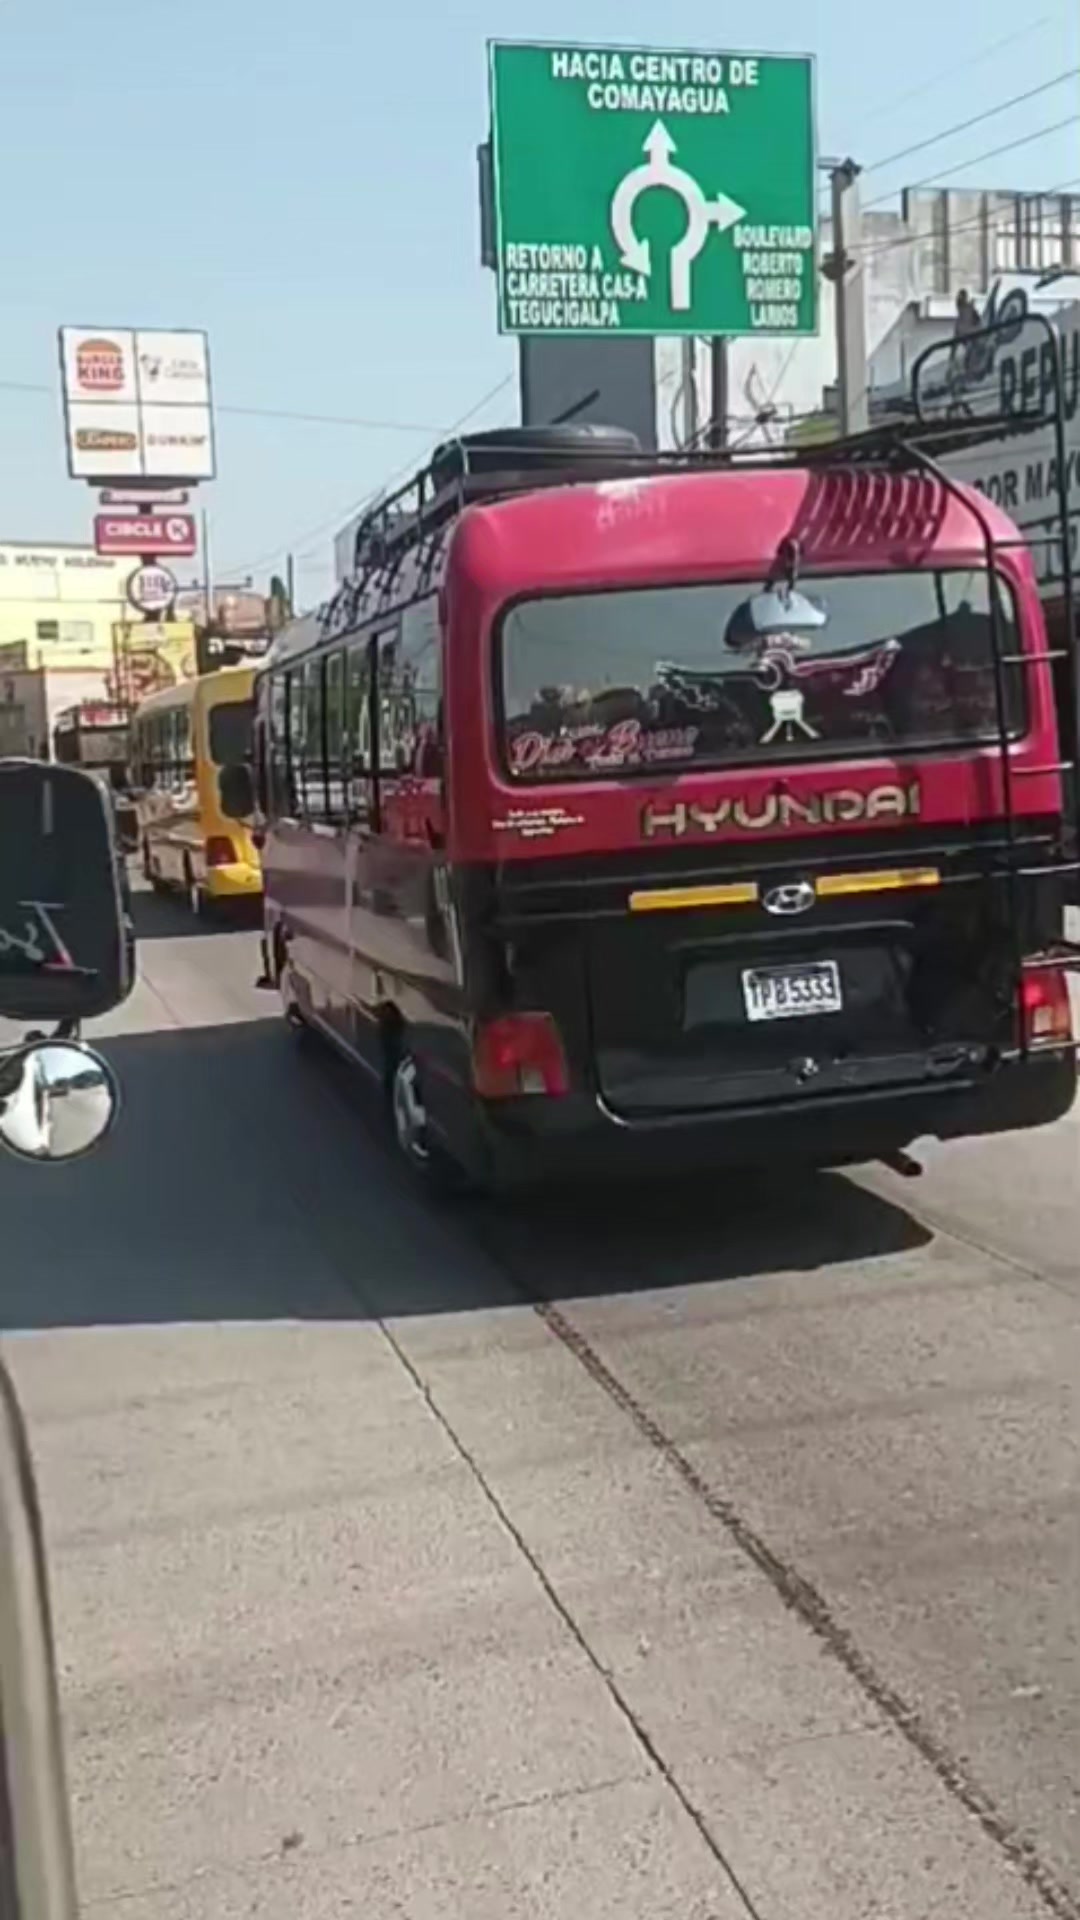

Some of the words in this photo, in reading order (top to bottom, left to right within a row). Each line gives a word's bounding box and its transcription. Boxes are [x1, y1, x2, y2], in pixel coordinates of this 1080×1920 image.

[552, 52, 624, 80] HACIA
[629, 55, 722, 84] CENTRO
[729, 60, 759, 85] DE
[587, 83, 730, 113] COMAYAGUA
[733, 224, 812, 249] BOULEVARD
[506, 242, 587, 270] RETORNO
[590, 245, 603, 271] A
[742, 252, 803, 276] ROBERTO
[507, 271, 600, 299] CARRETERA
[746, 277, 802, 301] ROMERO
[509, 299, 620, 326] TEGUCIGALPA
[78, 366, 125, 380] KING
[106, 521, 163, 537] CIRCLE
[643, 782, 921, 838] HYUNDAI
